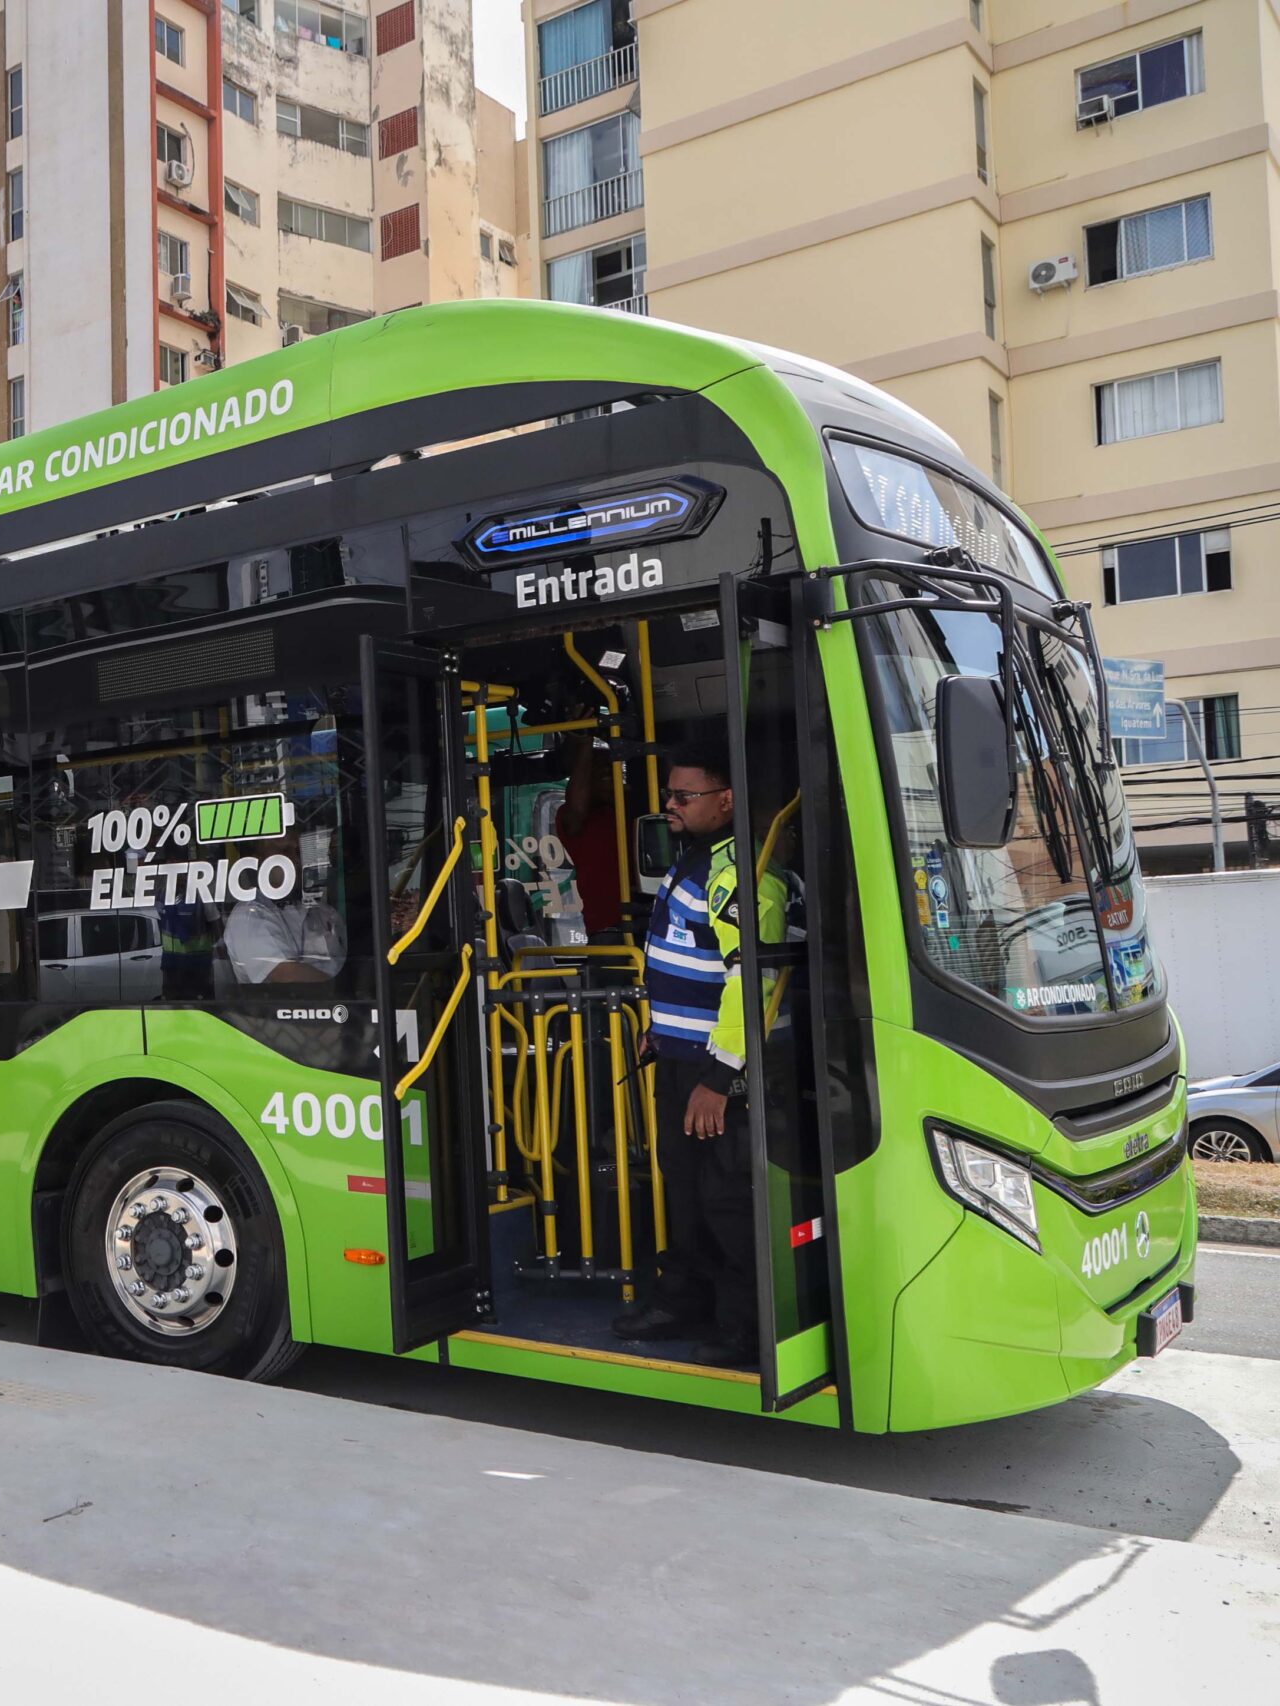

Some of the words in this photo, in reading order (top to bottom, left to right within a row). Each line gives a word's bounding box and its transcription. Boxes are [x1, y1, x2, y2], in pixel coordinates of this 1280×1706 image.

[44, 379, 294, 482] CONDICIONADO
[516, 553, 664, 609] Entrada
[87, 802, 192, 854] 100%
[89, 852, 297, 910] ELÉTRICO
[277, 1009, 332, 1020] CAIO
[1026, 986, 1040, 1007] AR
[1040, 983, 1096, 1006] CONDICIONADO
[260, 1092, 423, 1146] 40001
[1124, 1133, 1150, 1160] eletra
[1081, 1222, 1128, 1279] 40001
